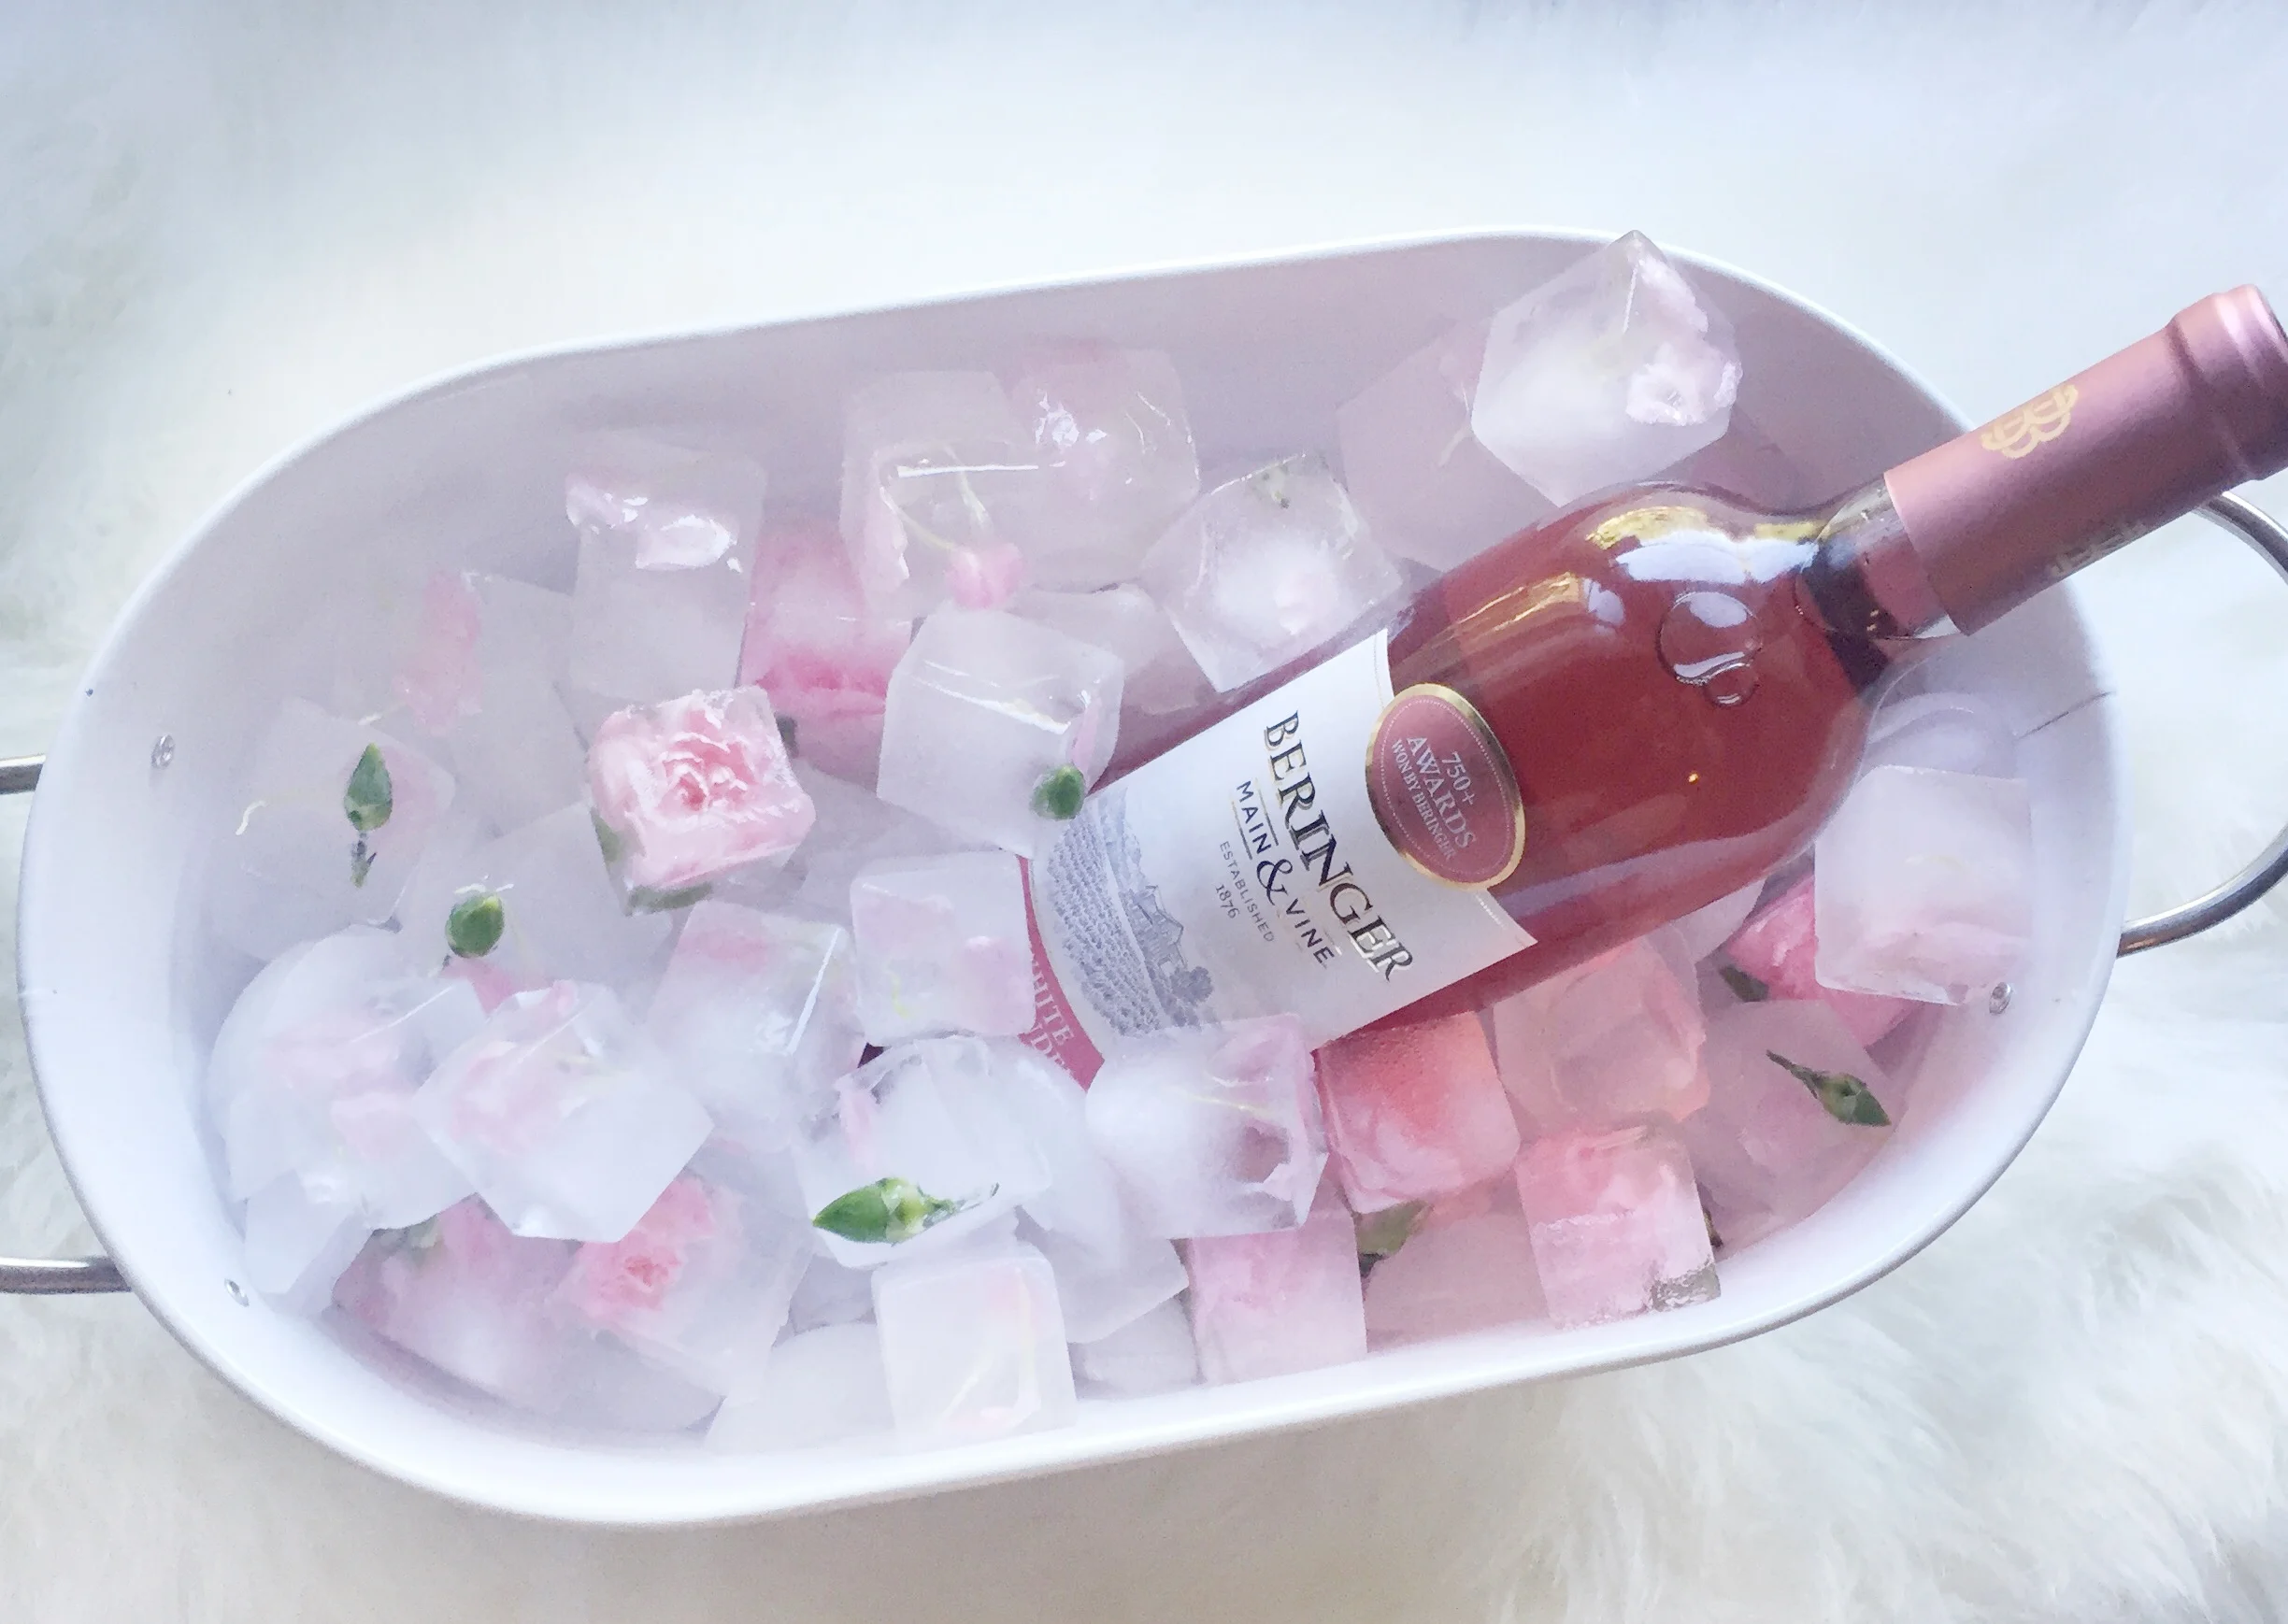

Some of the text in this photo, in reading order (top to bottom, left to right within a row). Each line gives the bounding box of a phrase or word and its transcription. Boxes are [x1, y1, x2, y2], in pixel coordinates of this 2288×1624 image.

[1391, 739, 1457, 859] WON BY BERINGER
[1406, 736, 1477, 848] AWARDS
[1441, 750, 1476, 805] 750+
[1220, 841, 1275, 942] ESTABLISHED
[1236, 780, 1335, 964] MAIN & VINE
[1264, 710, 1414, 981] BERINGER
[1215, 884, 1240, 919] 1876
[1031, 960, 1075, 1046] HITE
